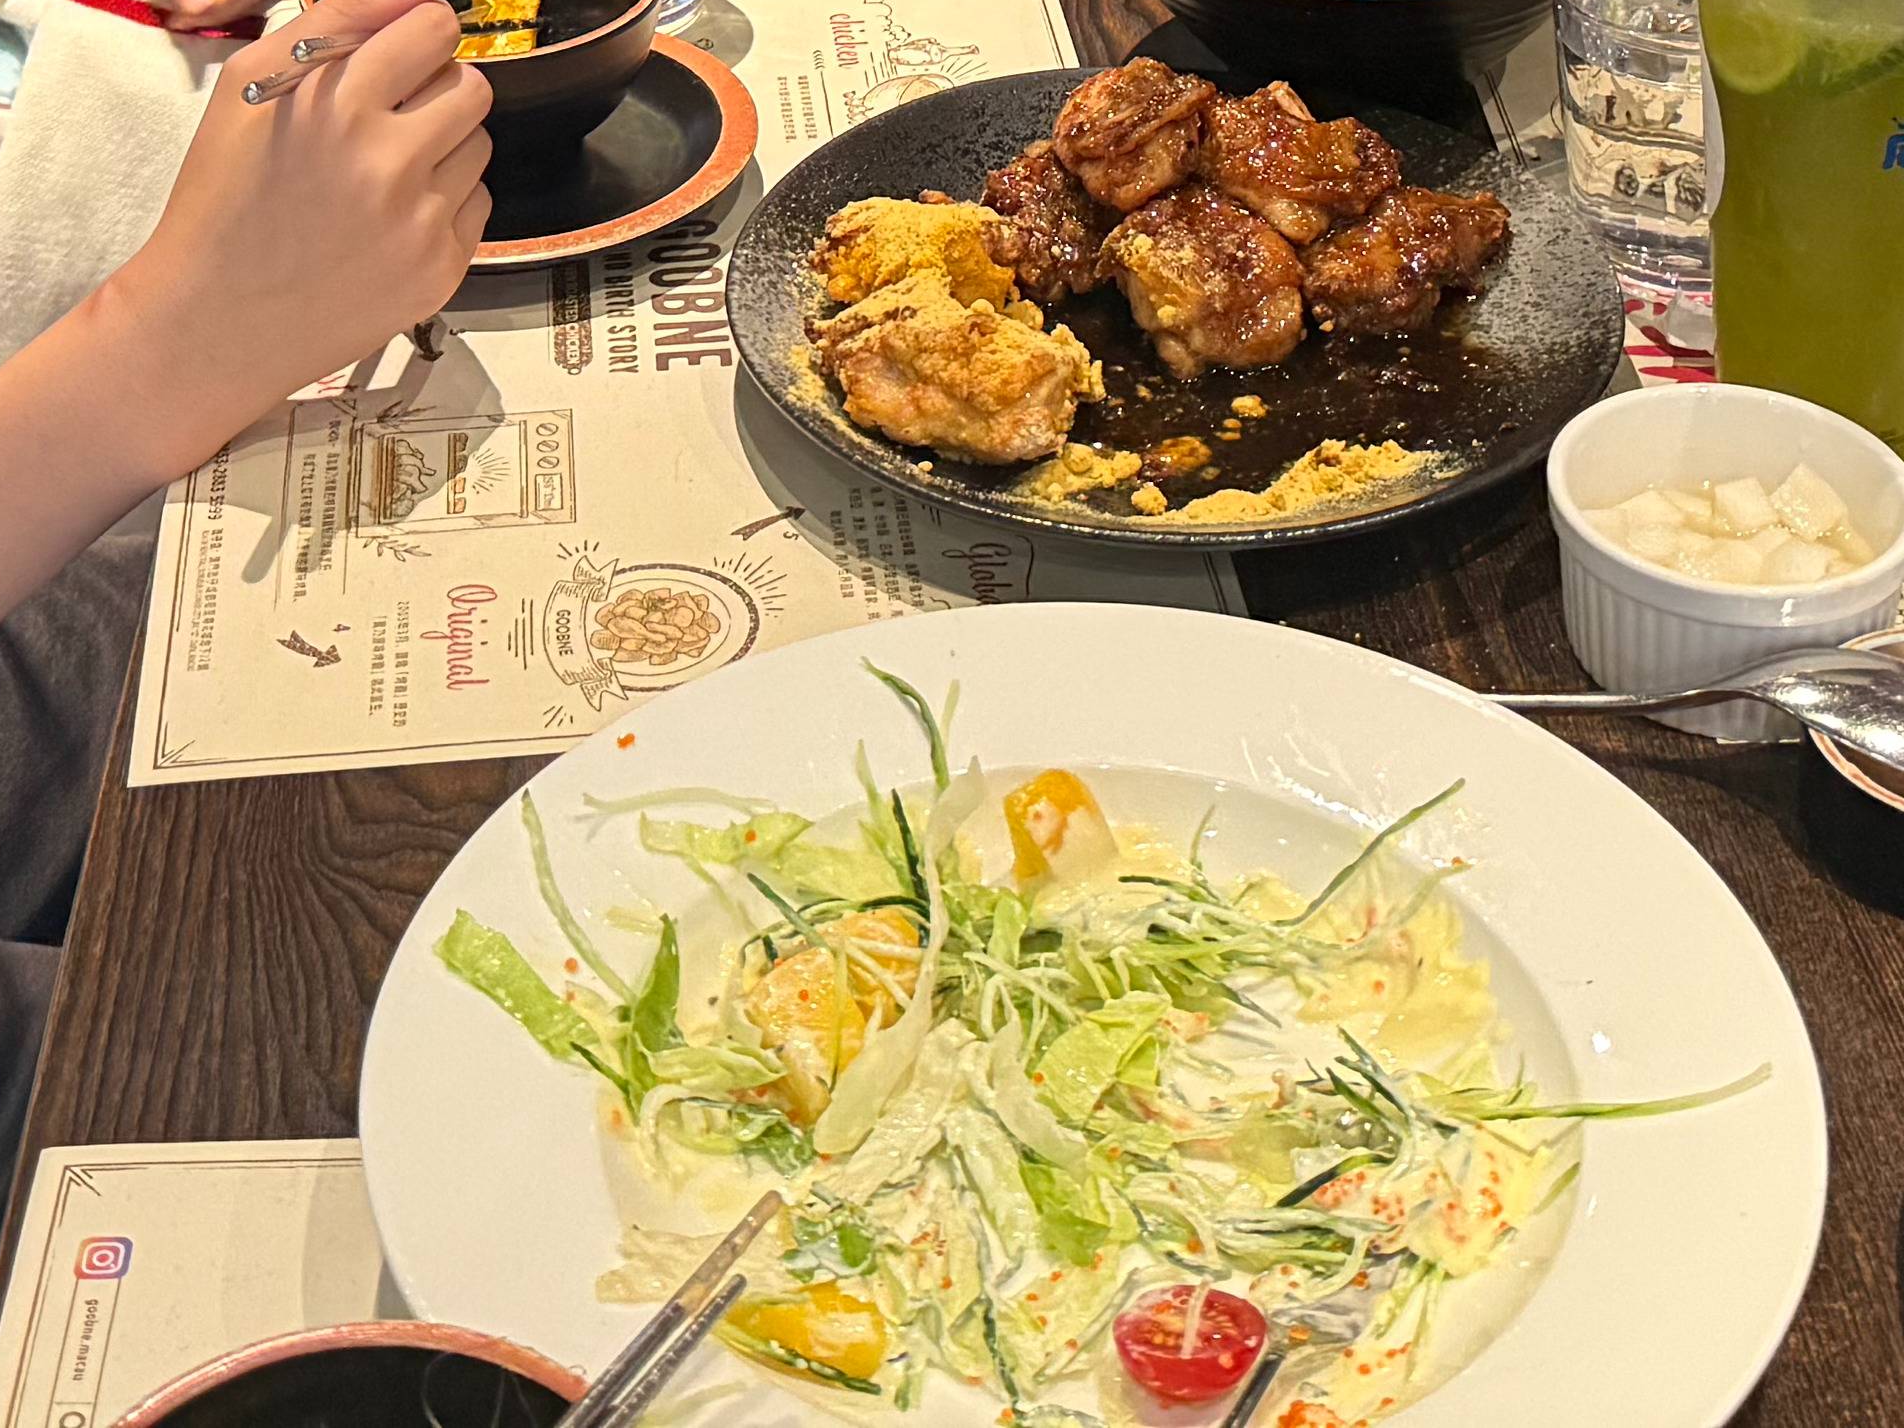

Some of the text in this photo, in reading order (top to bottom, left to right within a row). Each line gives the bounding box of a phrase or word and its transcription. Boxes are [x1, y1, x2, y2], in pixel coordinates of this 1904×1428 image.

[829, 13, 869, 68] chicken
[605, 276, 637, 318] BIRTH
[647, 218, 734, 373] GOOBNE
[564, 323, 582, 364] CHICKEN
[607, 325, 639, 375] STORY
[419, 583, 499, 692] Original
[556, 608, 574, 657] GOOBNE
[72, 1297, 100, 1383] goobne.macau
